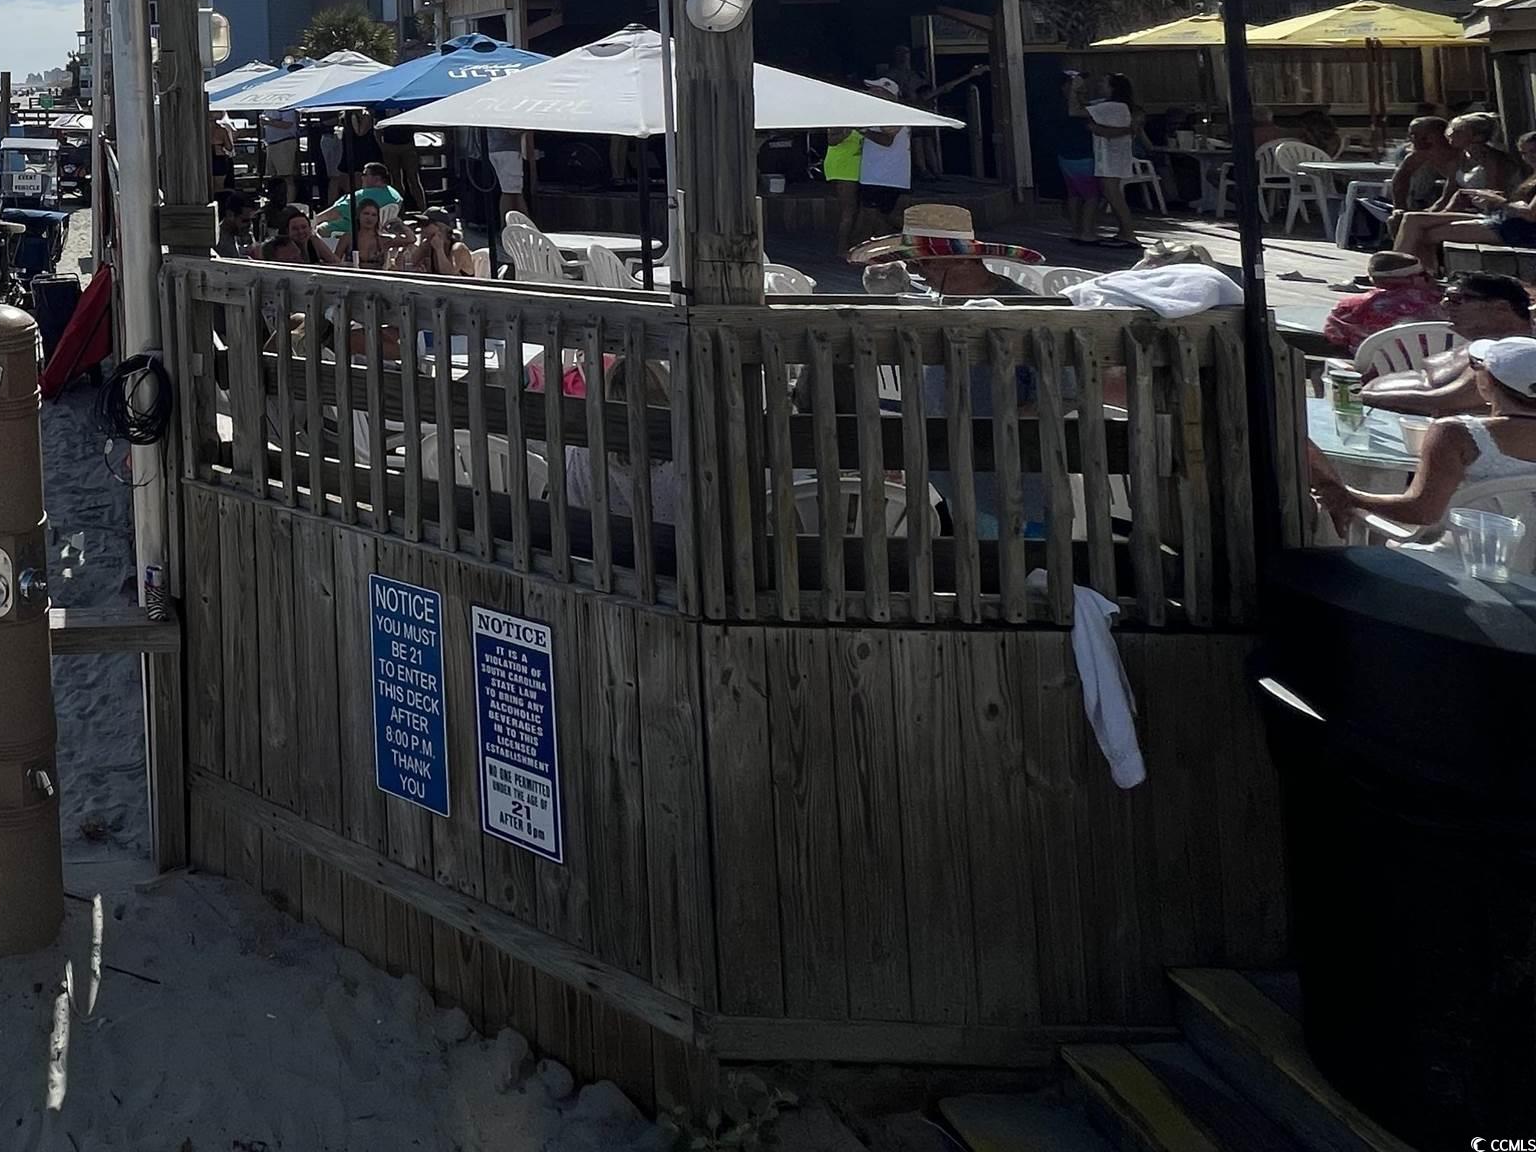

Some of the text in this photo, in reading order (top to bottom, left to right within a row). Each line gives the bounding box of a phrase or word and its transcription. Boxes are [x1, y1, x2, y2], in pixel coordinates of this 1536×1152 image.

[375, 583, 435, 625] NOTICE
[375, 614, 437, 647] YOU MUST
[477, 613, 547, 648] NOTICE
[391, 640, 422, 665] BE 21
[484, 653, 542, 678] VIOLATION OF
[496, 646, 528, 664] IT IS A
[378, 658, 438, 692] TO ENTER
[481, 663, 547, 692] SOUTH CAROLINA
[377, 679, 440, 716] THIS DECK
[484, 686, 544, 714] TO BRING ANY
[490, 677, 537, 700] STATE LAW
[390, 706, 429, 734] AFTER
[488, 710, 544, 736] BEVERAGES
[489, 699, 541, 724] ALCOHOLIC
[385, 725, 409, 748] 8:00
[493, 722, 539, 747] IN TO THIS
[497, 735, 537, 757] LICENSED
[391, 749, 431, 780] THANK
[485, 742, 549, 773] ESTABLISHMENT
[399, 773, 425, 799] YOU
[514, 773, 551, 799] PERMITTED
[499, 810, 524, 833] AFTER
[511, 800, 531, 821] 21
